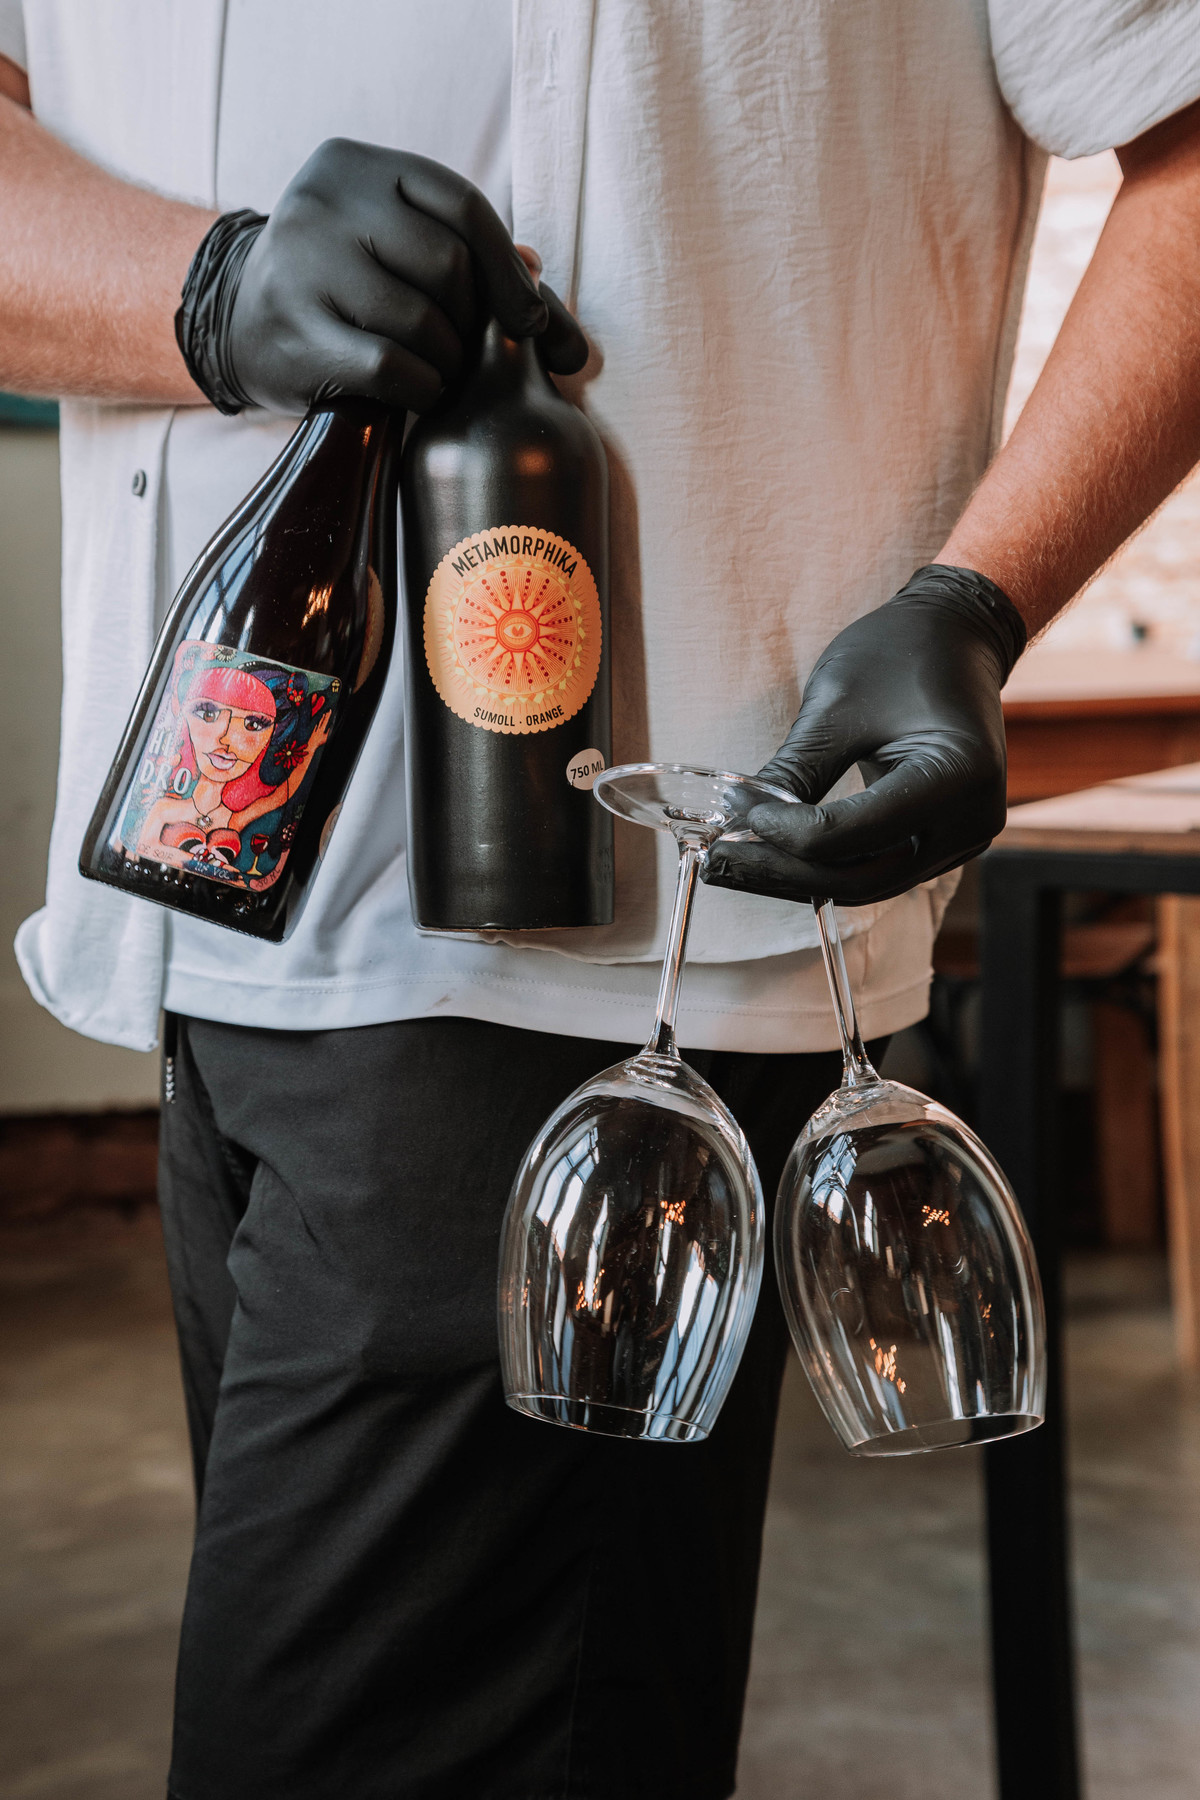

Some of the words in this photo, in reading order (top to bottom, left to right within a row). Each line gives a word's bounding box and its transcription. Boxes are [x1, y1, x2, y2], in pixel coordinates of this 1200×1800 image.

[451, 535, 579, 578] METAMORPHIKA
[473, 707, 515, 727] SUMOLL
[525, 705, 565, 727] ORANGE
[140, 758, 193, 795] DRO
[570, 765, 590, 780] 750
[591, 760, 604, 774] ML
